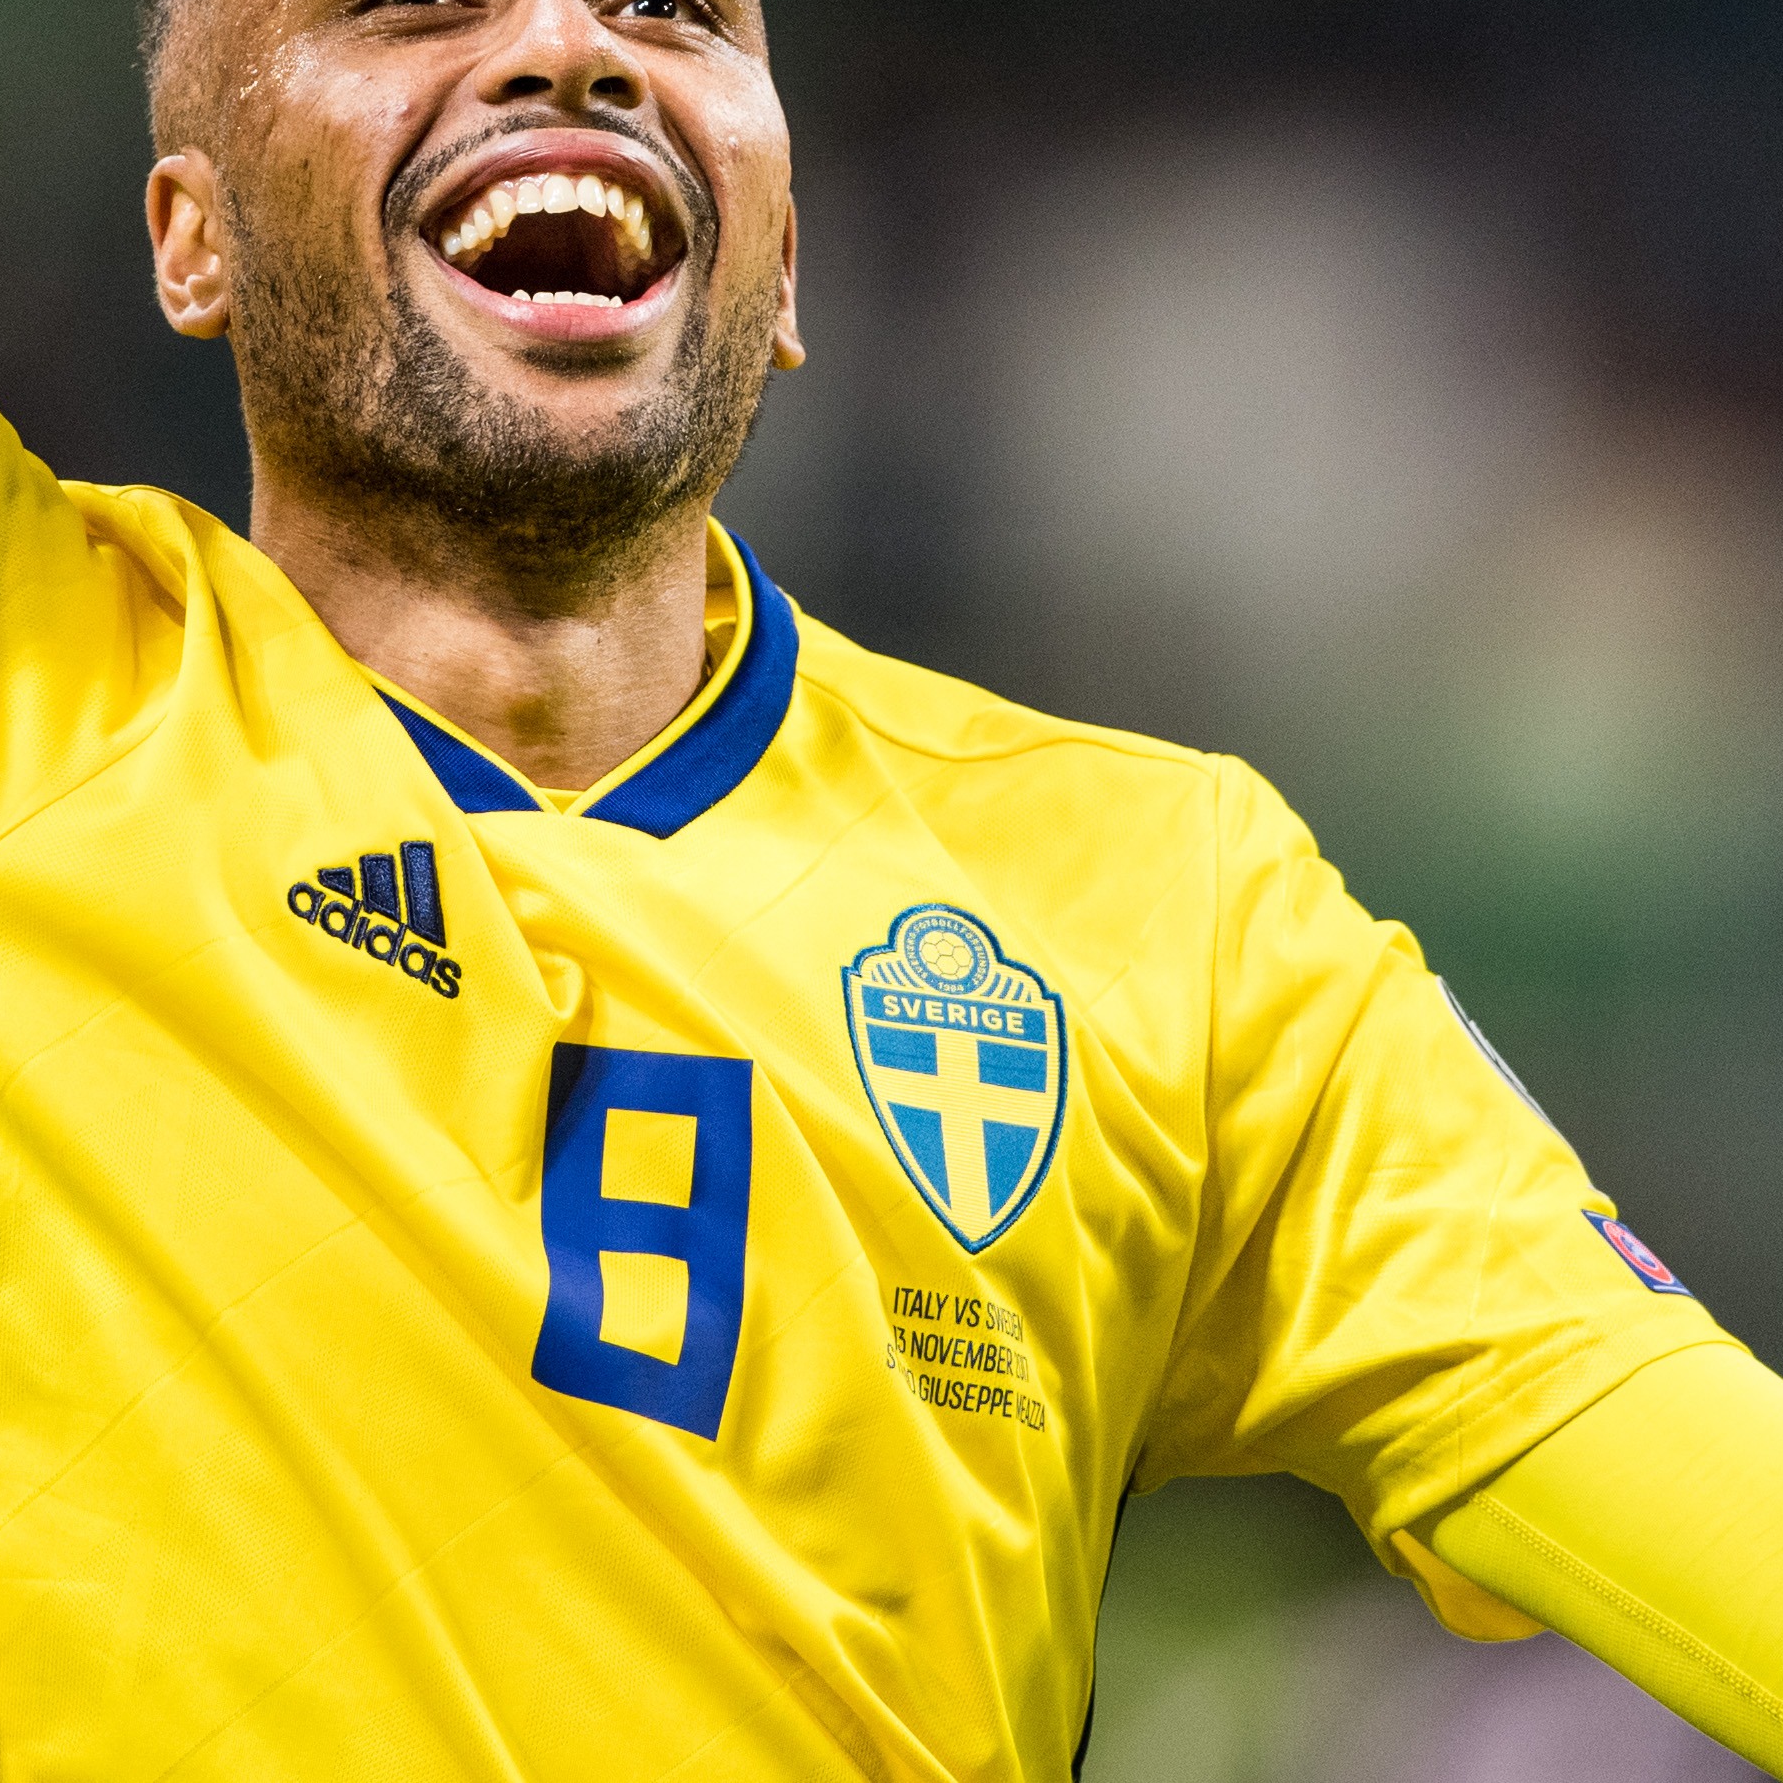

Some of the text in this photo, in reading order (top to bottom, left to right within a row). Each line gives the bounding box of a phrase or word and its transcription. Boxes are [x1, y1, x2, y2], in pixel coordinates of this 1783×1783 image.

[287, 881, 462, 999] adidas
[882, 995, 1025, 1035] SVERIGE
[531, 1041, 754, 1443] 8
[893, 1286, 950, 1321] ITALY
[954, 1296, 982, 1328] VS
[892, 1325, 907, 1354] 13
[910, 1330, 1014, 1377] NOVEMBER
[918, 1373, 1014, 1419] GIUSEPPE
